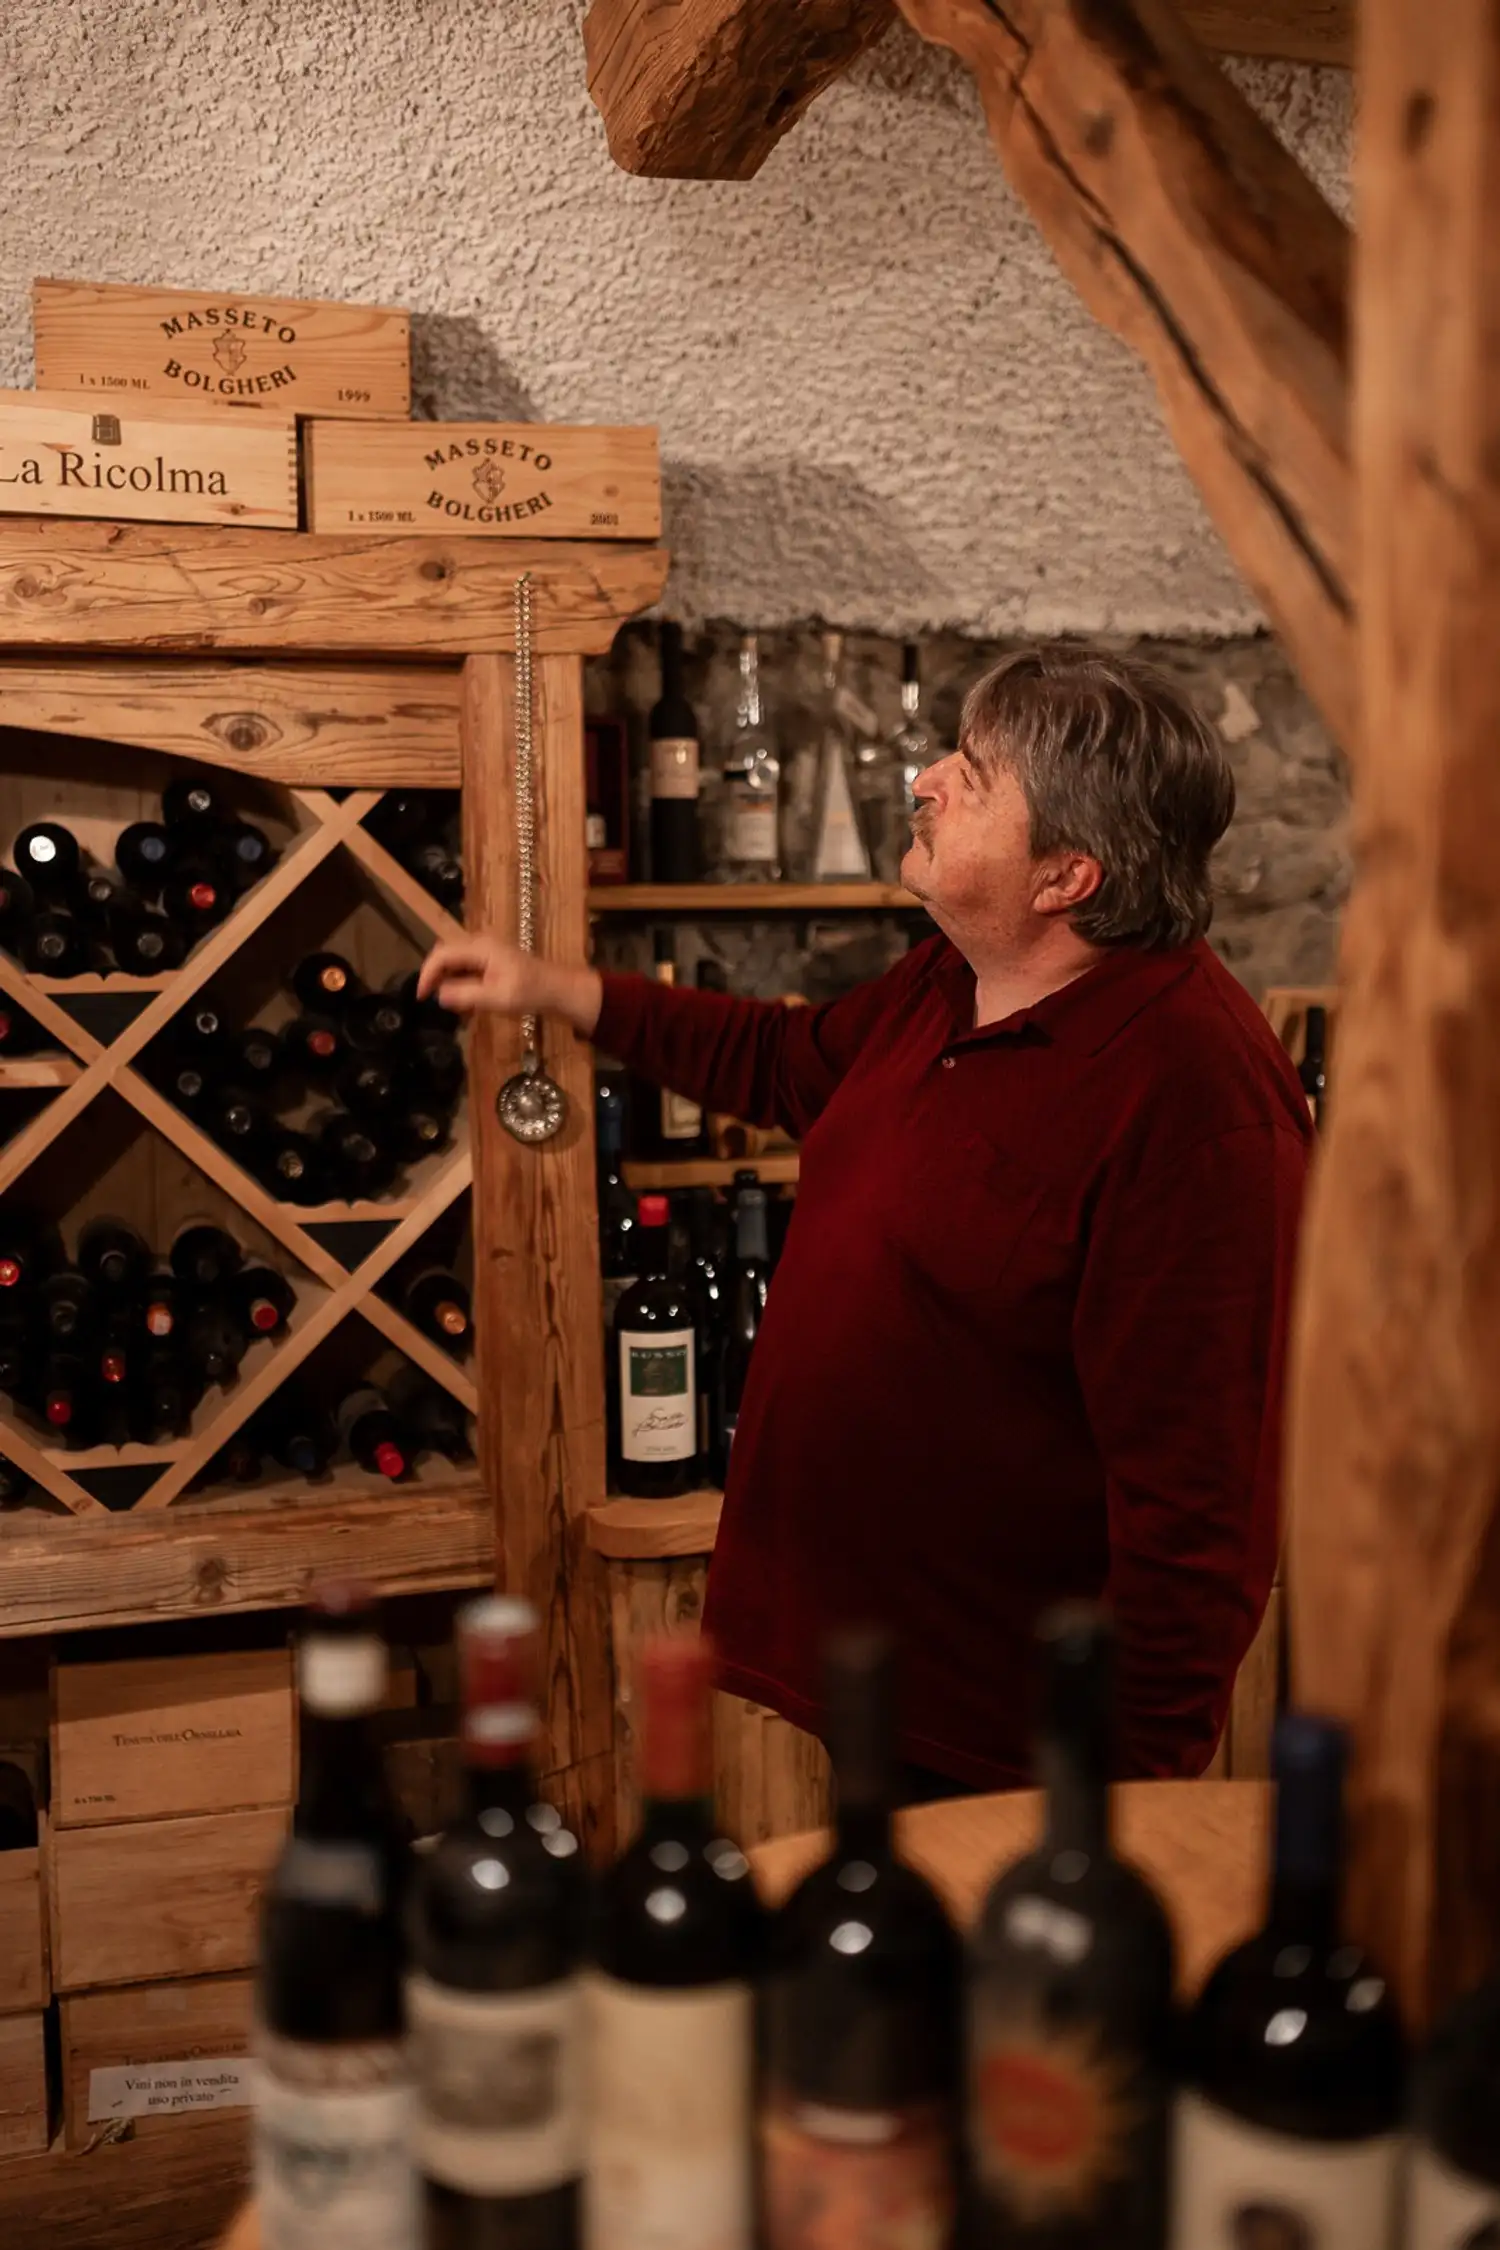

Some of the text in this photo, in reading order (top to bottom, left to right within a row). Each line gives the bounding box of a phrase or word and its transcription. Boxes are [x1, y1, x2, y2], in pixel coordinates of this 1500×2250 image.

[159, 307, 297, 344] MASSETO
[101, 376, 128, 387] 1500
[163, 358, 298, 396] BOLGHERI
[337, 388, 371, 402] 1999
[423, 438, 552, 472] MASSETO
[57, 452, 229, 496] Ricolma
[426, 490, 554, 523] BOLGHERI
[125, 2073, 239, 2091] Vini non in vendita
[148, 2091, 215, 2107] uso privato
